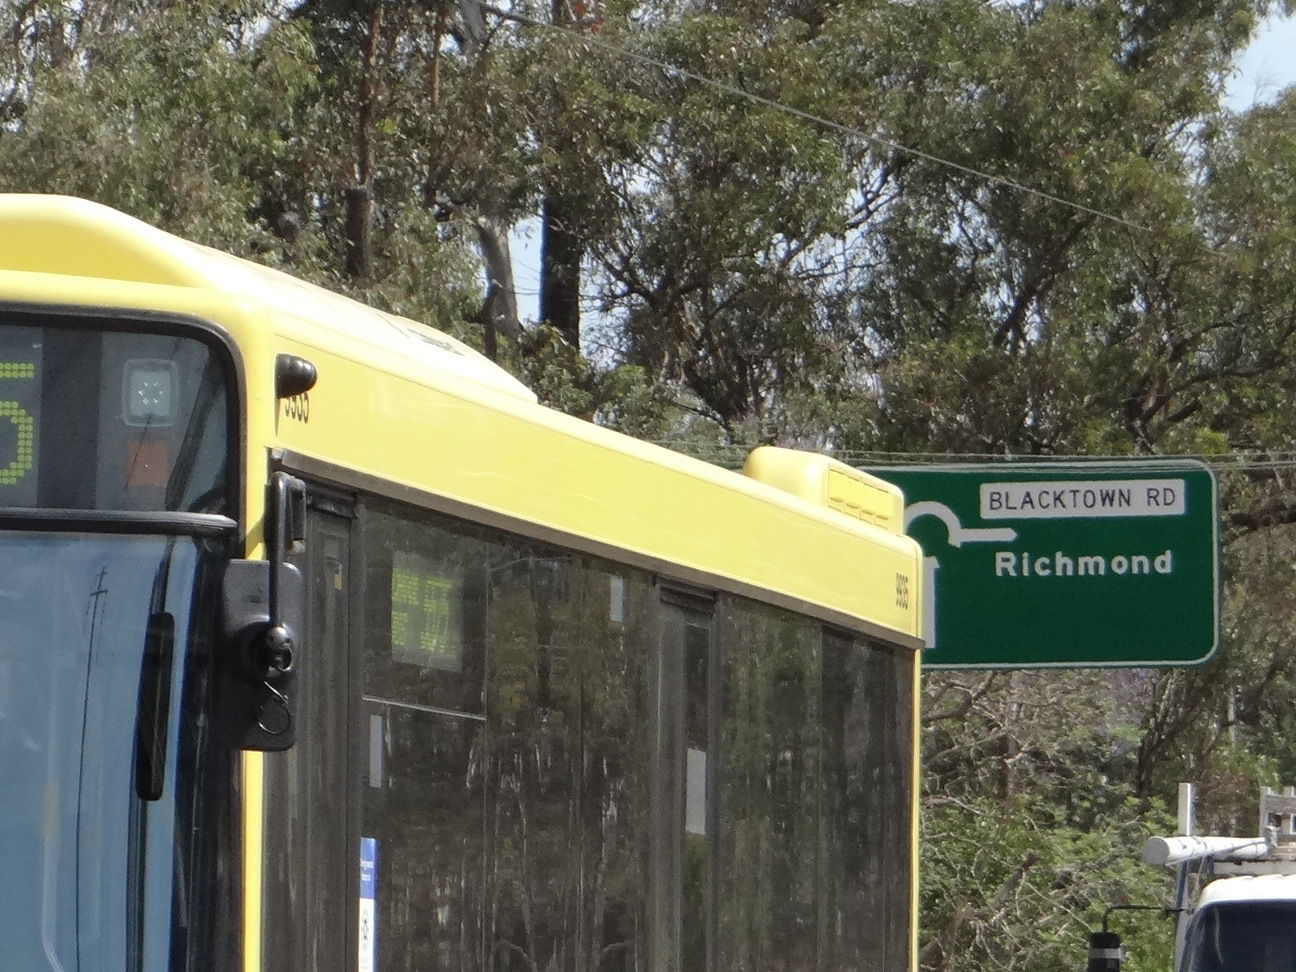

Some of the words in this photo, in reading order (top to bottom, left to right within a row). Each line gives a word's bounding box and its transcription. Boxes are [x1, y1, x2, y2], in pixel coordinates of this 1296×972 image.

[989, 488, 1132, 510] BLACKTOWN
[1146, 487, 1176, 507] RD
[994, 549, 1174, 577] Richmond
